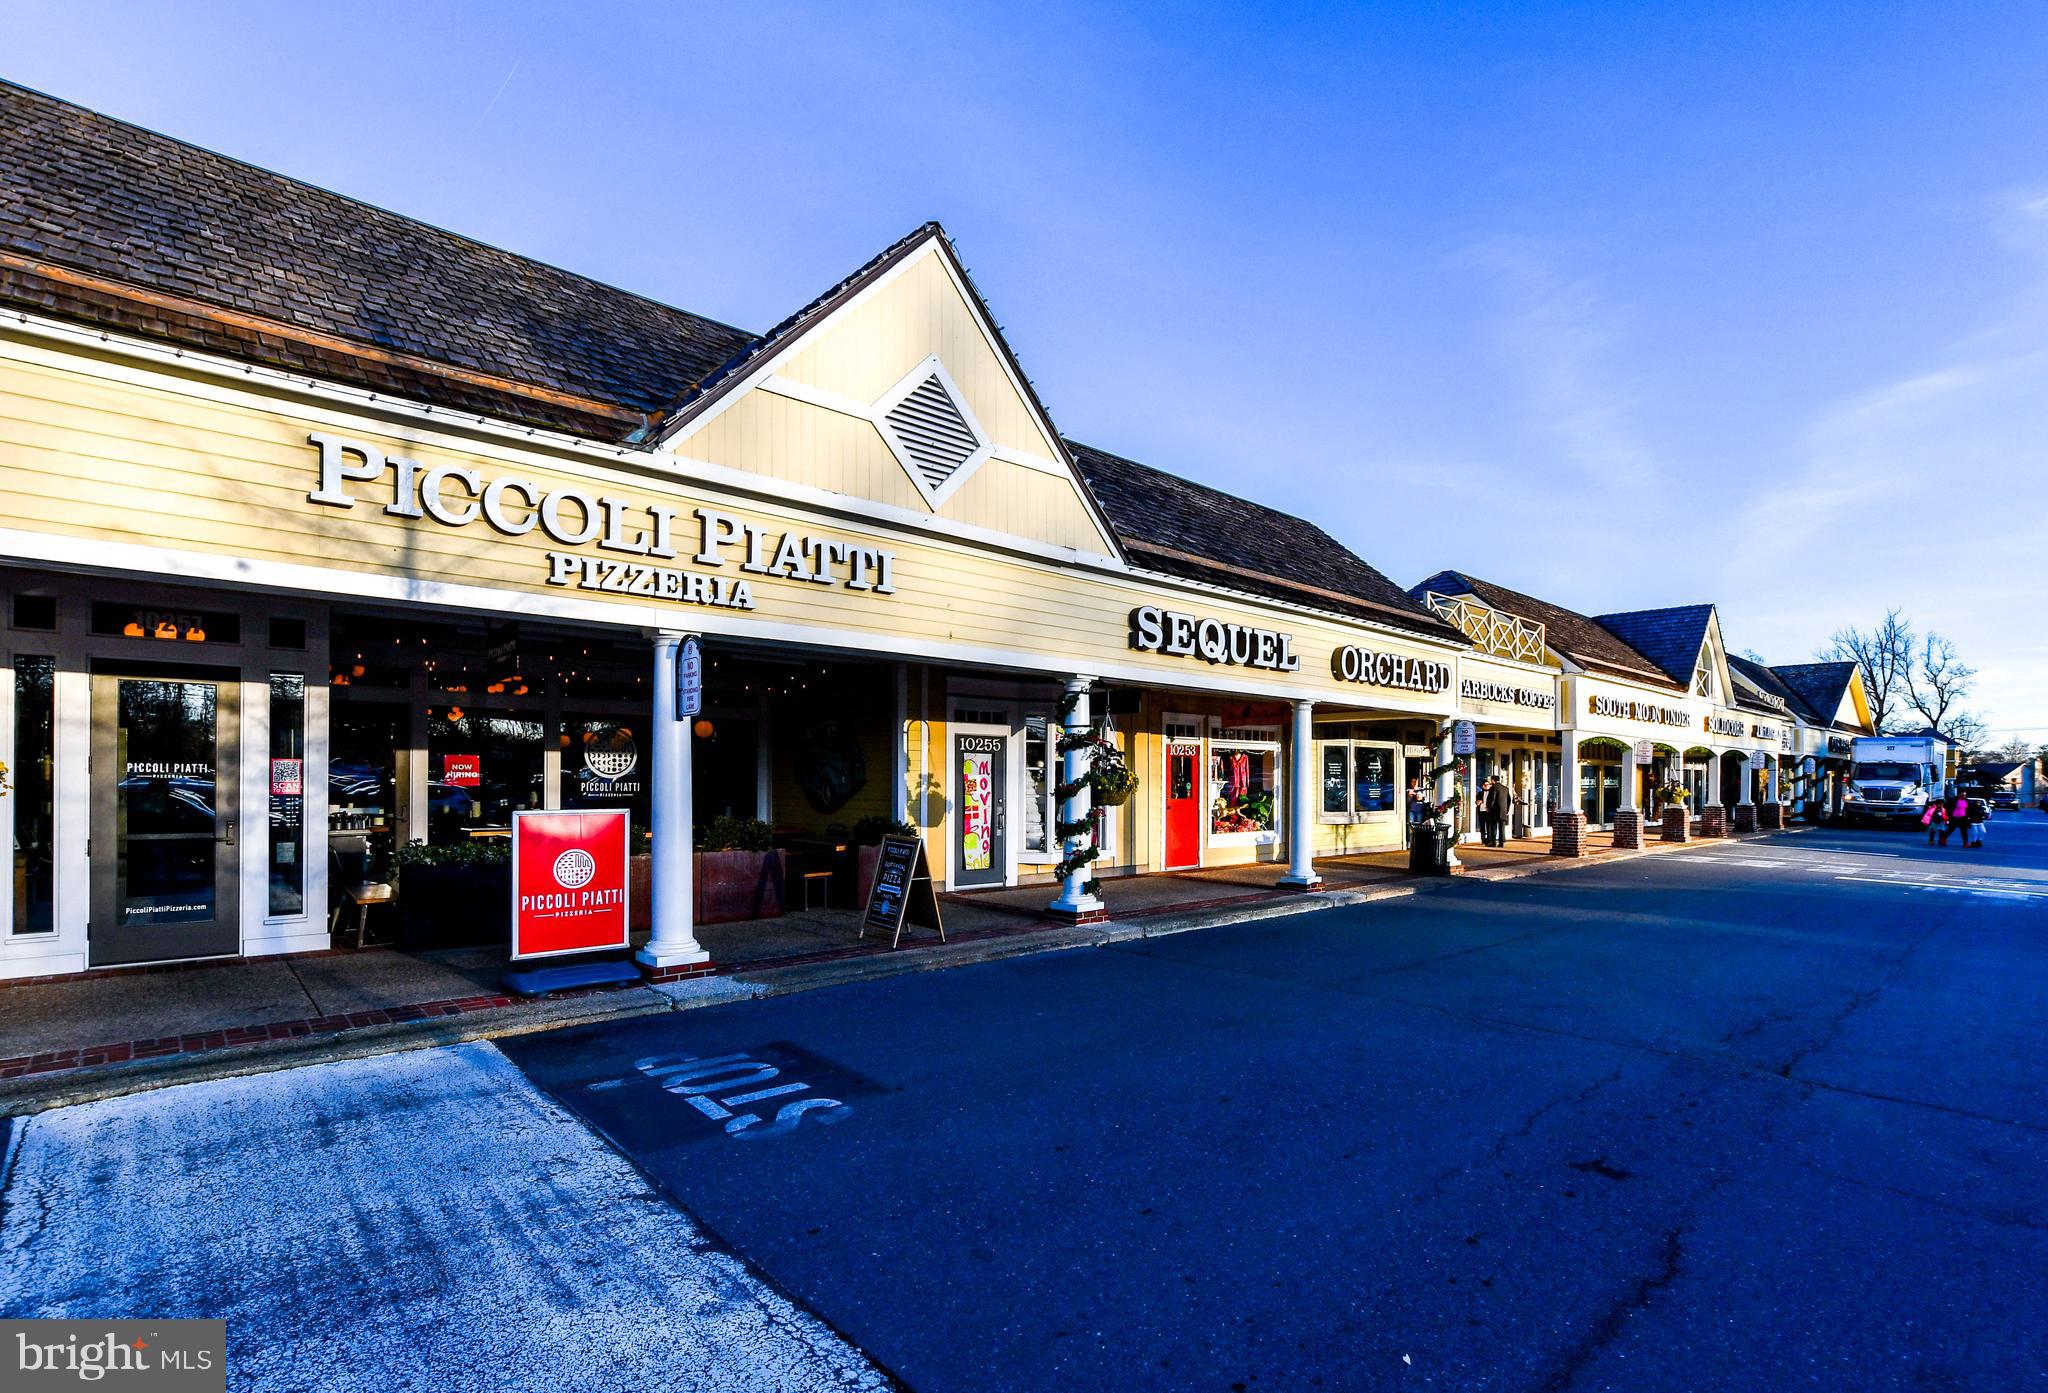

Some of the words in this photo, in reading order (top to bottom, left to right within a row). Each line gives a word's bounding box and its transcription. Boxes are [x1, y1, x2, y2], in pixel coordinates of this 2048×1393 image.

[307, 432, 677, 559] PICCOLI
[693, 507, 896, 594] PIATTI
[545, 552, 757, 610] PIZZERIA
[1130, 605, 1300, 672] SEQUEL
[687, 661, 694, 670] NO
[1333, 645, 1452, 694] ORCHARD
[1593, 695, 1631, 719] SOUTH
[1663, 707, 1690, 727] UNDER
[959, 737, 1001, 751] 10255
[1169, 744, 1196, 755] 10253
[127, 762, 169, 773] PICCOLI
[174, 763, 208, 773] PIATTI
[580, 782, 612, 792] PICCOLI
[615, 782, 640, 792] PIATTI
[883, 873, 901, 883] PIZZA
[521, 892, 576, 911] PICCOLI
[582, 888, 623, 906] PIATTI
[125, 904, 207, 914] PiccoliPiattiPizzeria.com
[555, 910, 593, 918] PIZZERIA
